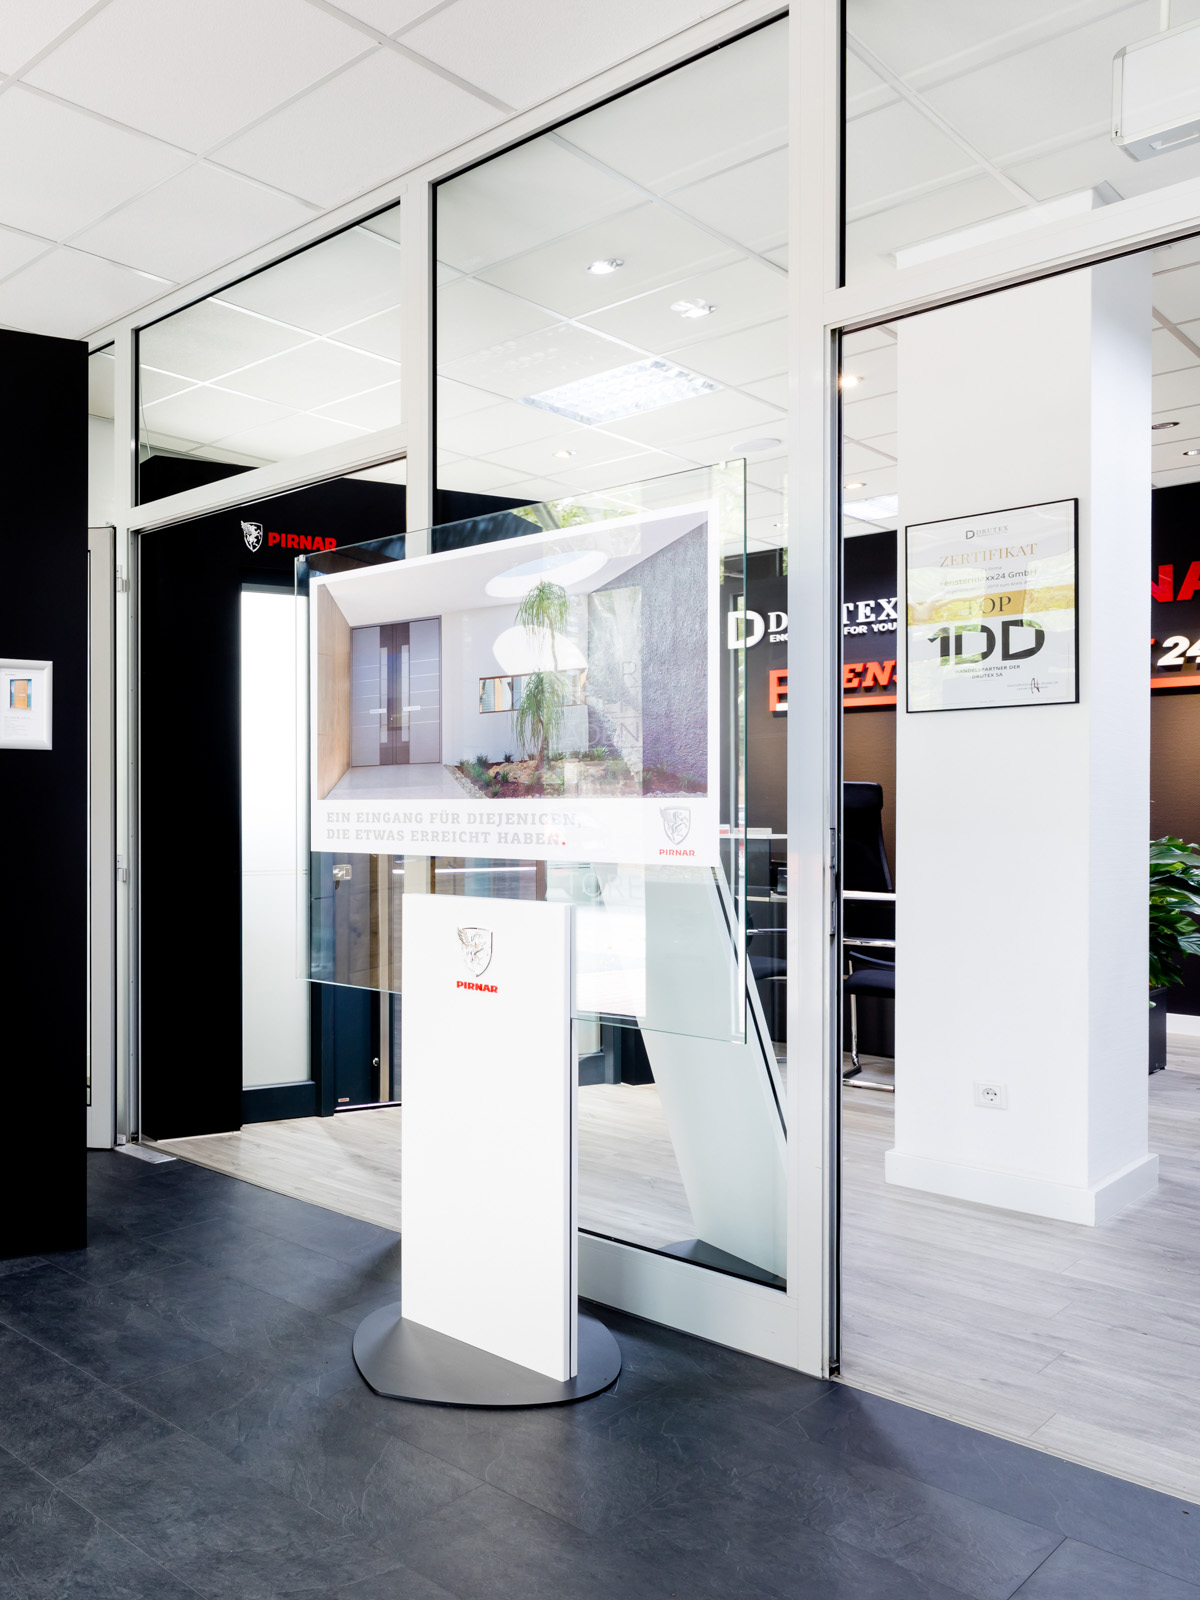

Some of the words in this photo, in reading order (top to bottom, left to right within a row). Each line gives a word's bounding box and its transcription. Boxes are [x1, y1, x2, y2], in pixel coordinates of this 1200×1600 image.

[268, 532, 337, 552] PIRNAR
[940, 543, 1038, 568] ZERTIFIKAT
[1008, 568, 1037, 579] GmbH
[965, 596, 1011, 615] TOP
[844, 625, 867, 635] FOR
[326, 812, 350, 823] EIN
[356, 812, 423, 824] EINGANG
[429, 810, 460, 824] FÜR
[326, 829, 350, 840] DIE
[355, 830, 405, 842] ETWAS
[411, 831, 491, 844] ERREICHT
[659, 849, 695, 857] PIRNAR
[456, 980, 498, 994] PIRNAR
